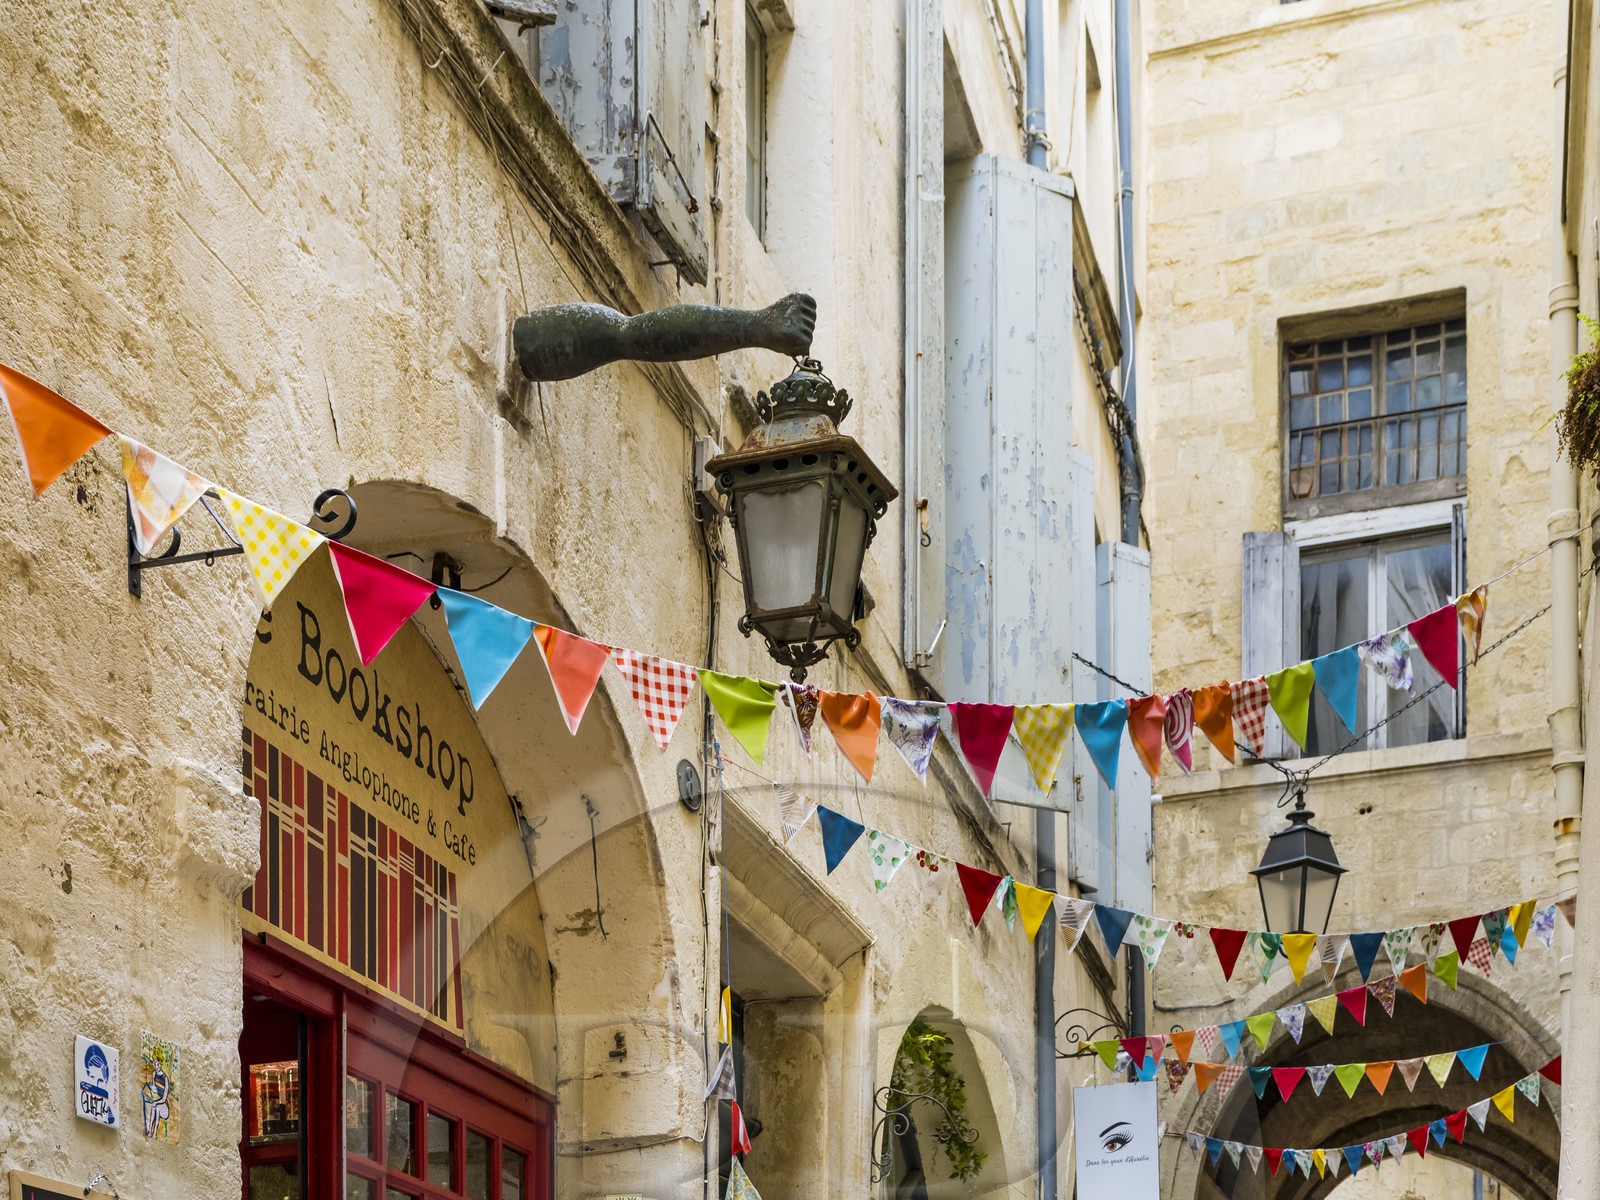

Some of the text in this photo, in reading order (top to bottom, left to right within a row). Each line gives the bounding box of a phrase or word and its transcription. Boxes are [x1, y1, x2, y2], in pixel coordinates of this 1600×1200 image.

[297, 601, 474, 816] Bookshop
[320, 730, 419, 824] Anglophone
[427, 809, 436, 838] &
[1086, 1159, 1099, 1167] Dans
